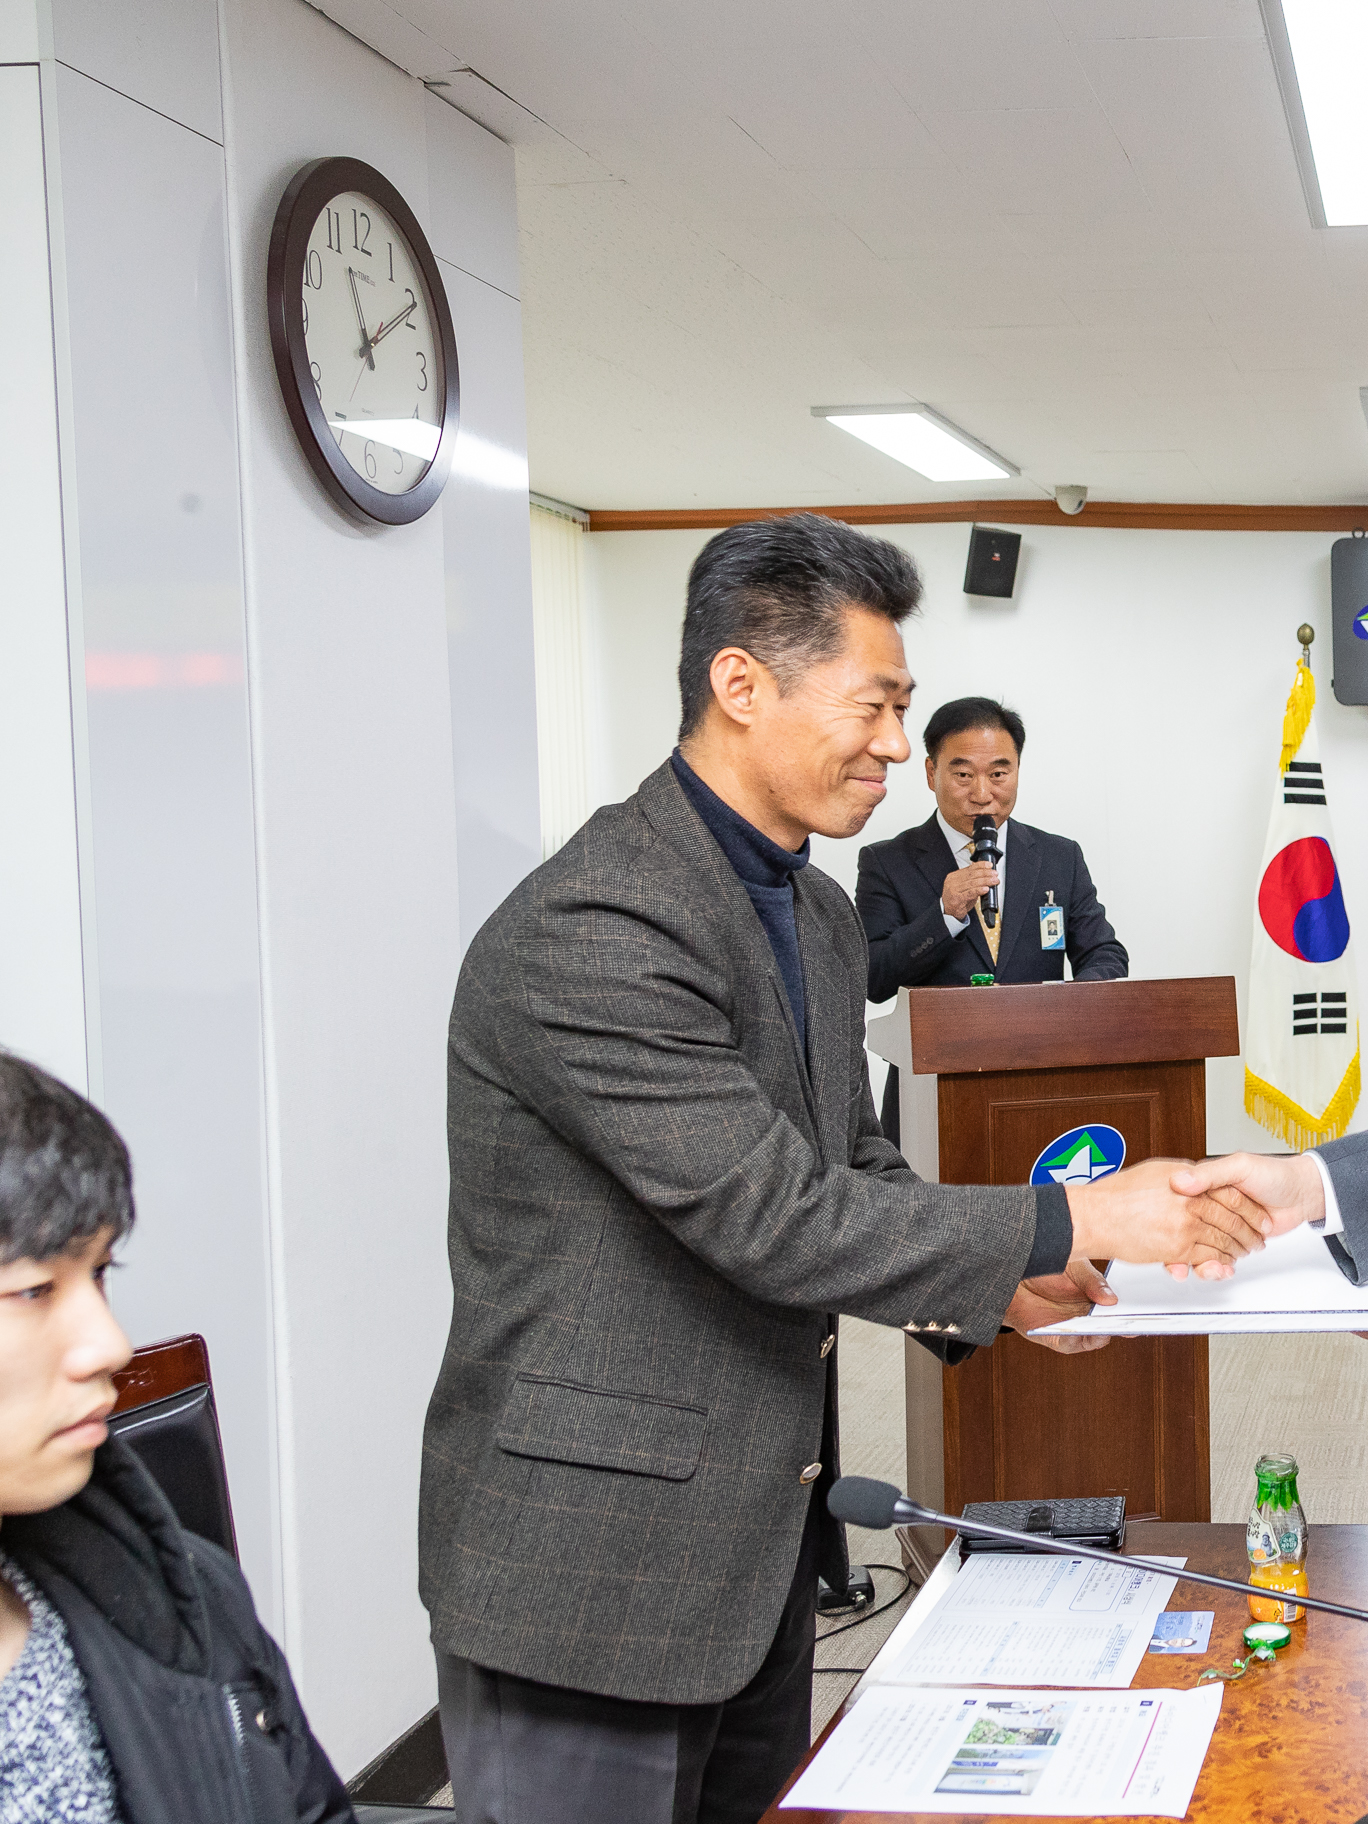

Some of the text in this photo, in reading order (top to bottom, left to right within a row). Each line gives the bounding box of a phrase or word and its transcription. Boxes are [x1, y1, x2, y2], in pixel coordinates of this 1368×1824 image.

[325, 206, 343, 255] 11
[351, 207, 373, 257] 12
[386, 241, 396, 284] 1
[404, 287, 417, 331] 2
[415, 351, 428, 392] 3
[364, 439, 377, 479] 6
